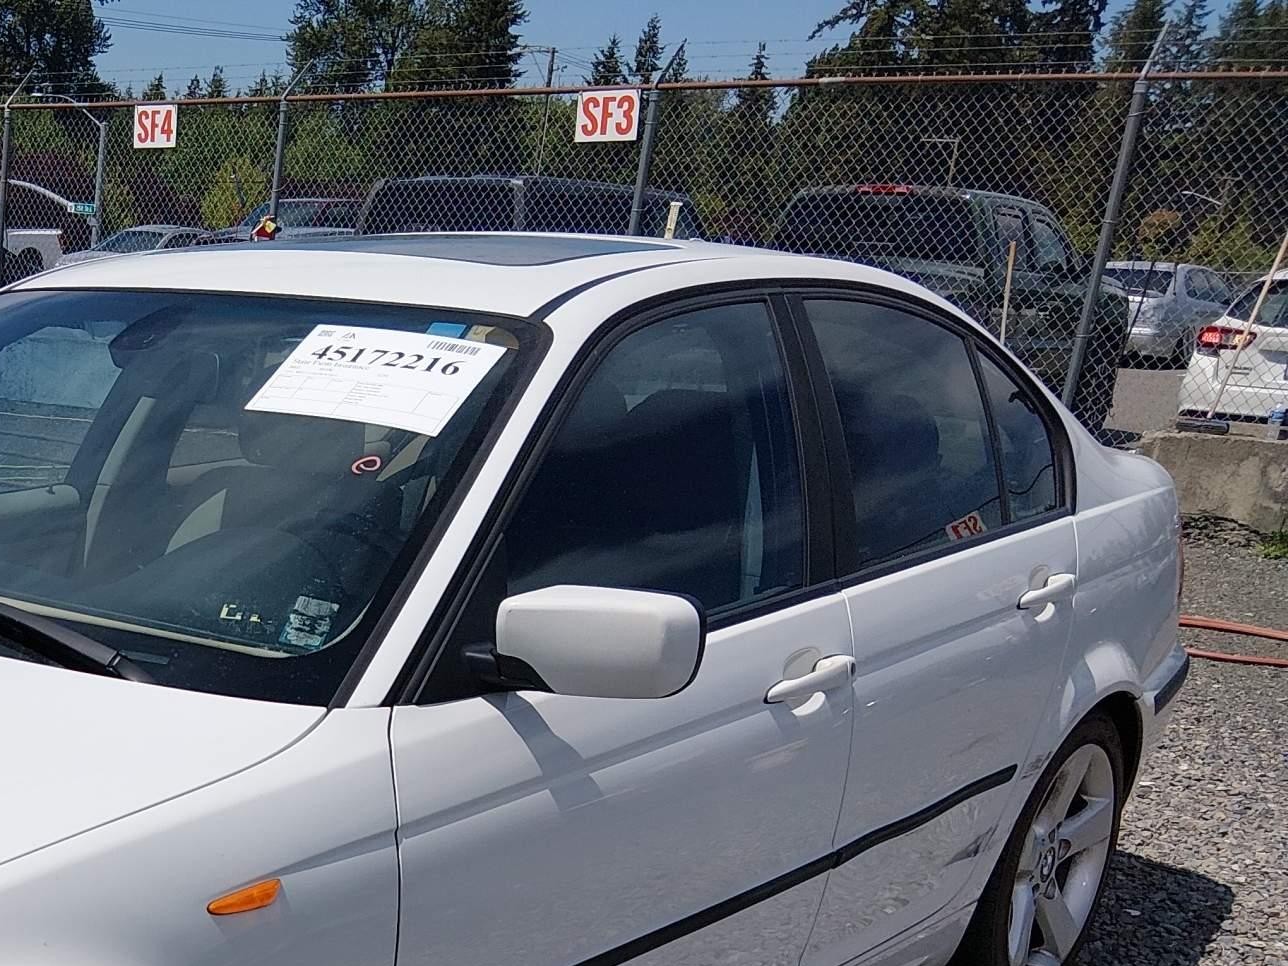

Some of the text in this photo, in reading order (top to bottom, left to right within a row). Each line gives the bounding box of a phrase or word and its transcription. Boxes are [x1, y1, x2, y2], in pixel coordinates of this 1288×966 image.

[137, 109, 174, 144] SF4
[581, 95, 635, 136] SF3
[311, 344, 466, 376] 45172216
